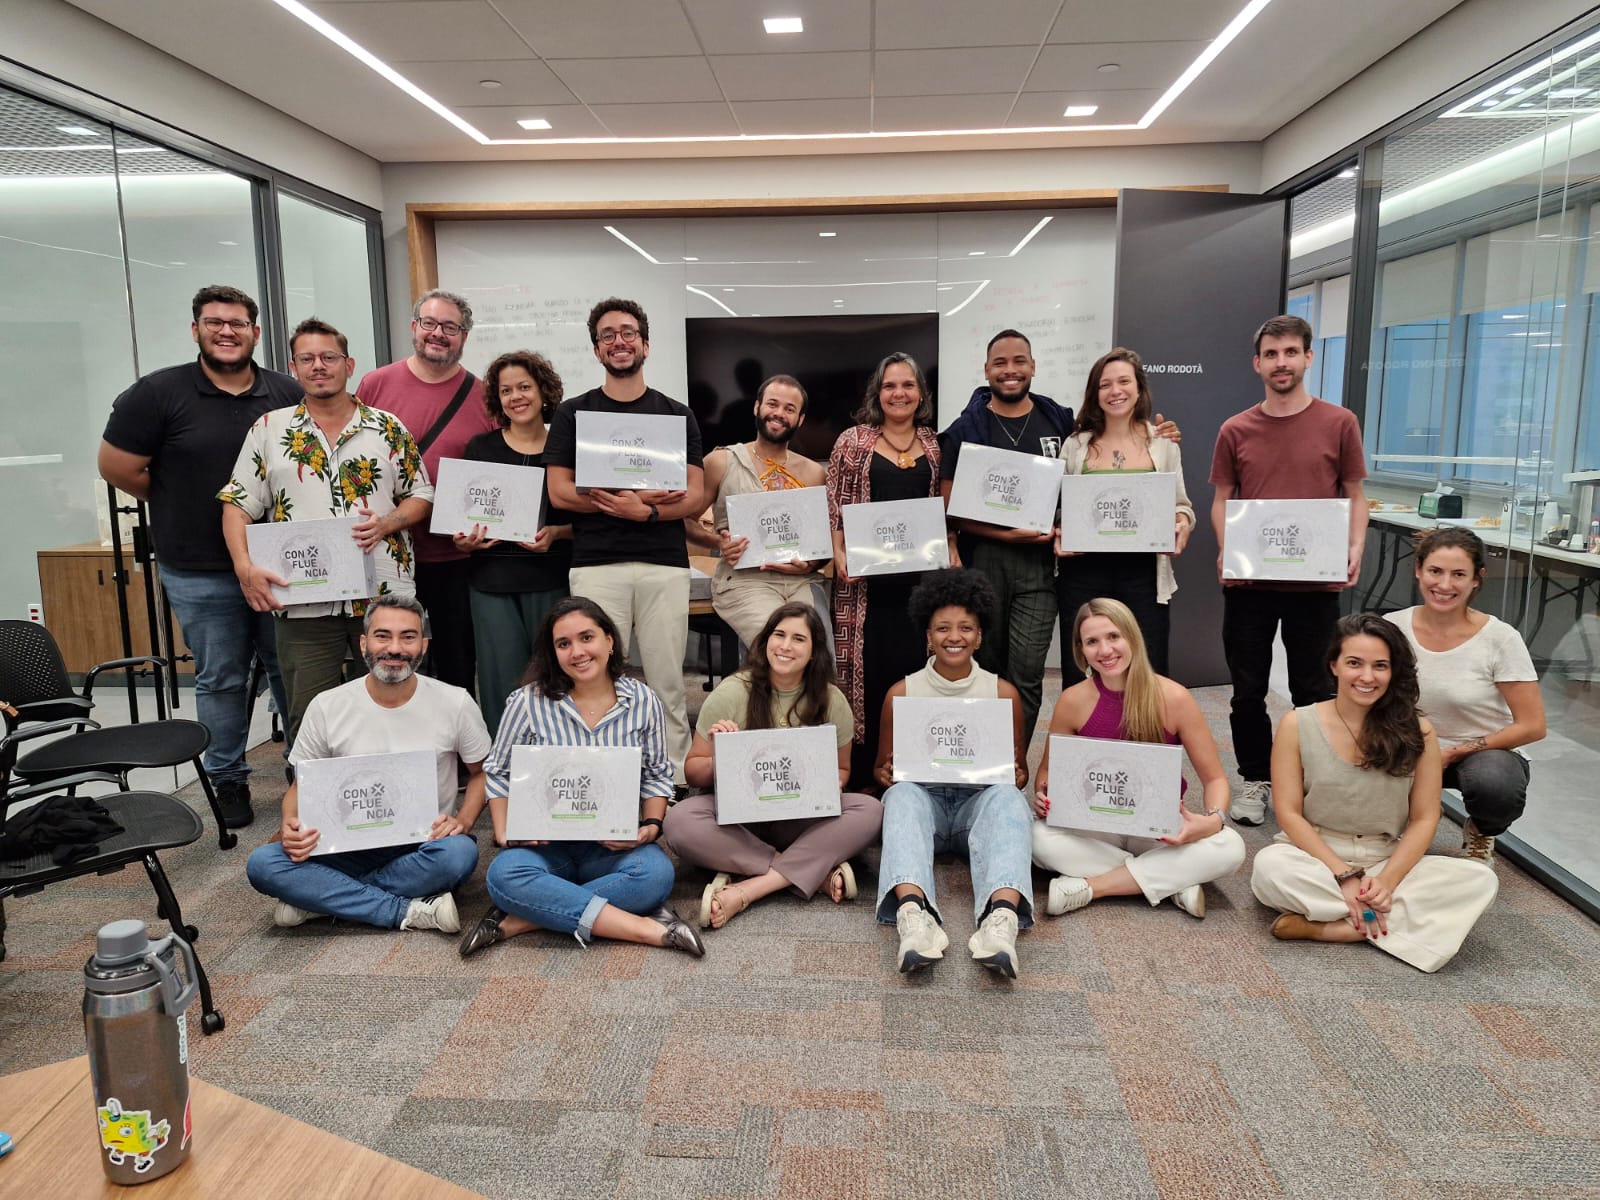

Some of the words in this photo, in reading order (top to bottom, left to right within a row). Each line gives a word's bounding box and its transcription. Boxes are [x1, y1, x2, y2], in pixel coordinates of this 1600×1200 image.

[1167, 362, 1204, 374] RODOTÀ
[629, 458, 652, 466] NCIA
[988, 473, 1007, 484] CON
[469, 487, 488, 497] CON
[992, 485, 1015, 494] FLUE
[474, 497, 497, 507] FLUE
[1001, 494, 1022, 505] NCIA
[1096, 501, 1117, 510] CON
[483, 507, 505, 516] NCIA
[1103, 511, 1128, 519] FLUE
[760, 517, 779, 526] CON
[1114, 520, 1138, 528] NCIA
[767, 525, 790, 534] FLUE
[876, 527, 894, 535] CON
[1262, 528, 1284, 536] CON
[779, 532, 799, 542] NCIA
[1269, 538, 1296, 546] FLUE
[285, 550, 305, 560] CON
[1280, 547, 1307, 556] NCIA
[292, 559, 317, 569] FLUE
[305, 568, 328, 578] NCIA
[930, 726, 951, 736] CON
[937, 737, 964, 747] FLUE
[950, 747, 975, 757] NCIA
[755, 761, 777, 771] CON
[763, 771, 789, 782] FLUE
[1089, 771, 1112, 783] CON
[551, 778, 575, 788] CON
[776, 781, 801, 792] NCIA
[343, 788, 368, 799] CON
[1096, 783, 1125, 795] FLUE
[558, 790, 587, 800] FLUE
[351, 798, 382, 810] FLUE
[571, 801, 598, 811] NCIA
[1109, 795, 1136, 808] NCIA
[366, 808, 395, 820] NCIA
